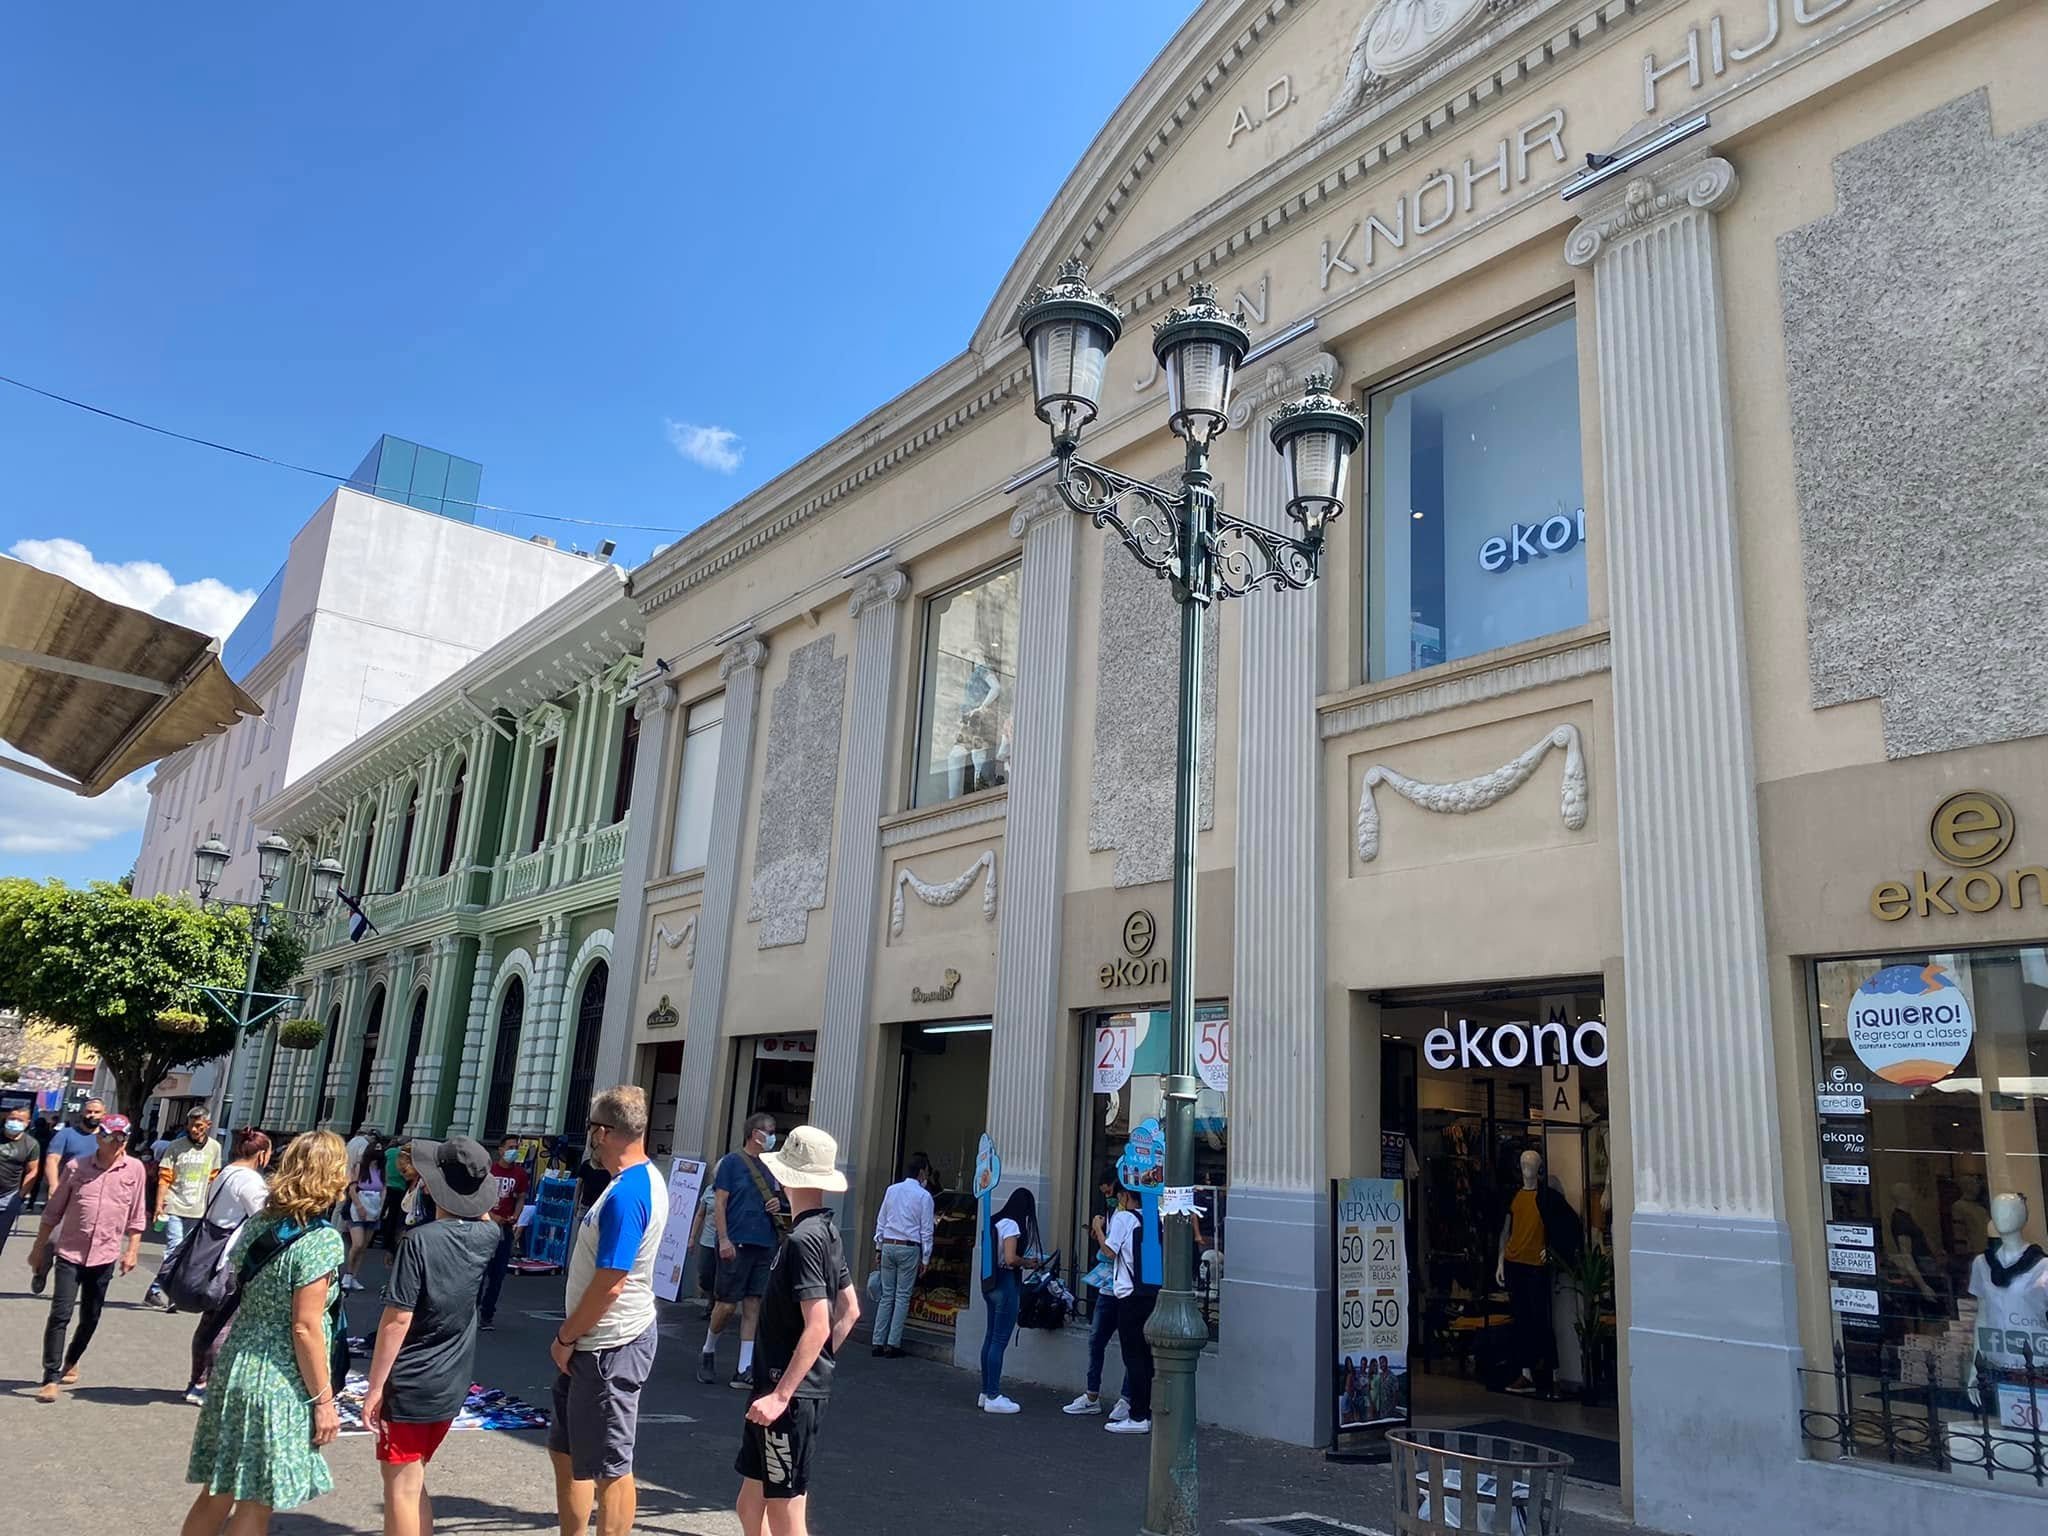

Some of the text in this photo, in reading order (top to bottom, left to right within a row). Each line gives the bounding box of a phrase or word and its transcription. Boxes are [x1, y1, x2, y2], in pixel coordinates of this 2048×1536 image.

[1226, 74, 1300, 149] A.D.
[1133, 276, 1271, 393] JN
[1319, 108, 1568, 291] KNÖHR
[1870, 865, 2048, 922] ekon
[1098, 957, 1168, 989] ekon
[1424, 1019, 1608, 1069] ekono
[1854, 1027, 1968, 1043] Regresar a clases
[1817, 1082, 1864, 1093] ekono
[1823, 1132, 1865, 1143] ekono
[1844, 1143, 1865, 1153] Plus
[1339, 1201, 1401, 1223] VERANO
[1341, 1235, 1364, 1264] 50
[1831, 1258, 1847, 1267] SER
[1848, 1259, 1873, 1270] PARTE
[1342, 1300, 1364, 1329] 50
[1370, 1299, 1399, 1327] 50
